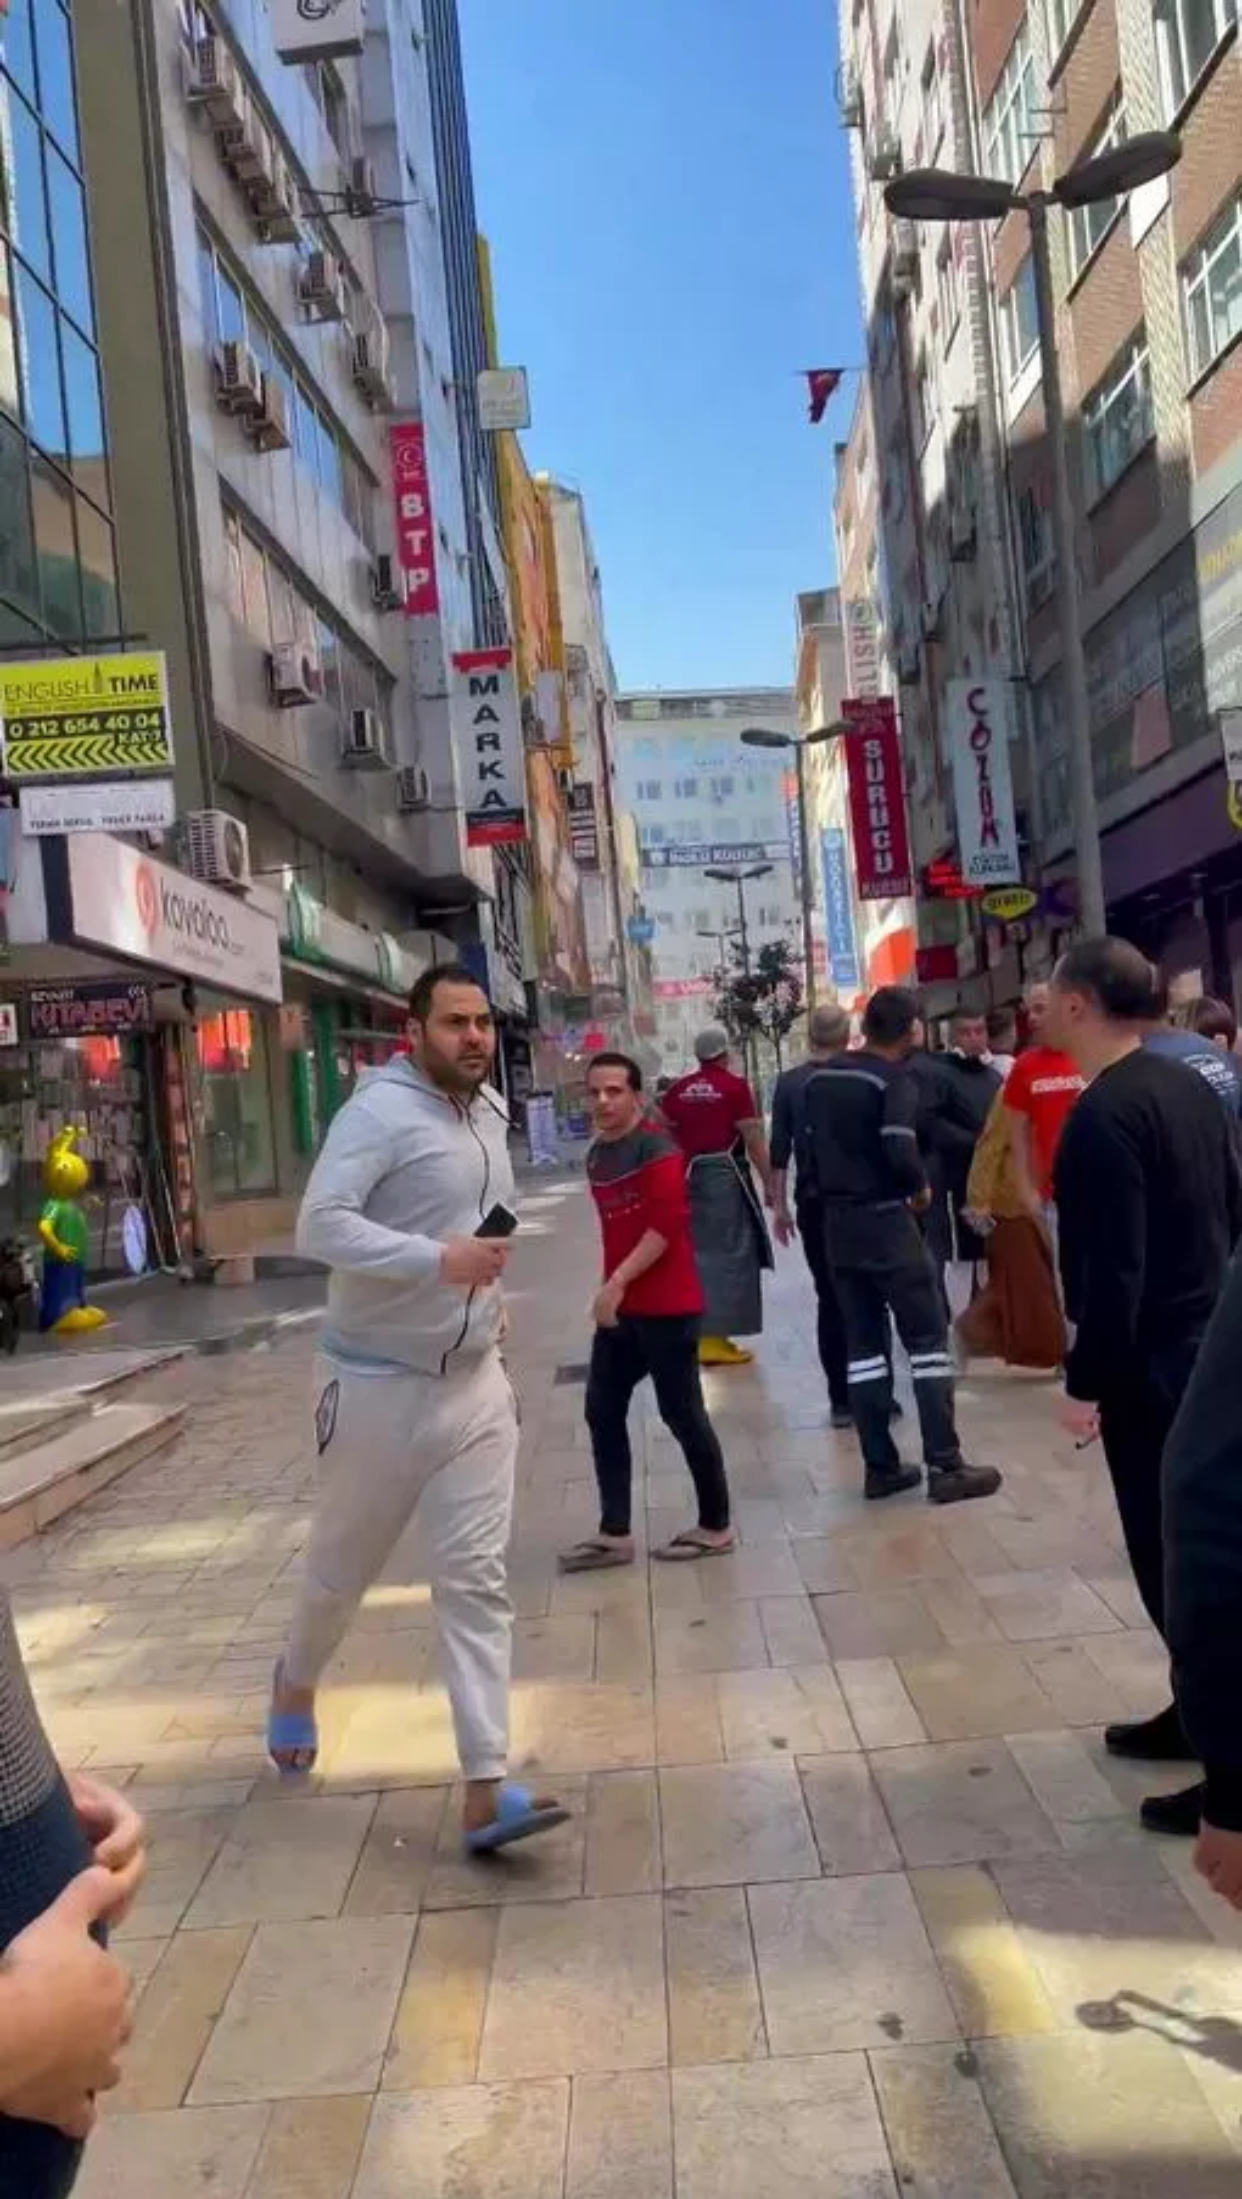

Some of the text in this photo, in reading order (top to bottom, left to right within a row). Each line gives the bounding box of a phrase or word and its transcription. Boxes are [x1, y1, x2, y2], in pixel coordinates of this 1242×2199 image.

[401, 492, 430, 592] BTP
[108, 673, 158, 693] TIME
[105, 713, 131, 731] 40
[136, 711, 161, 730] 04
[469, 674, 507, 809] MARKA
